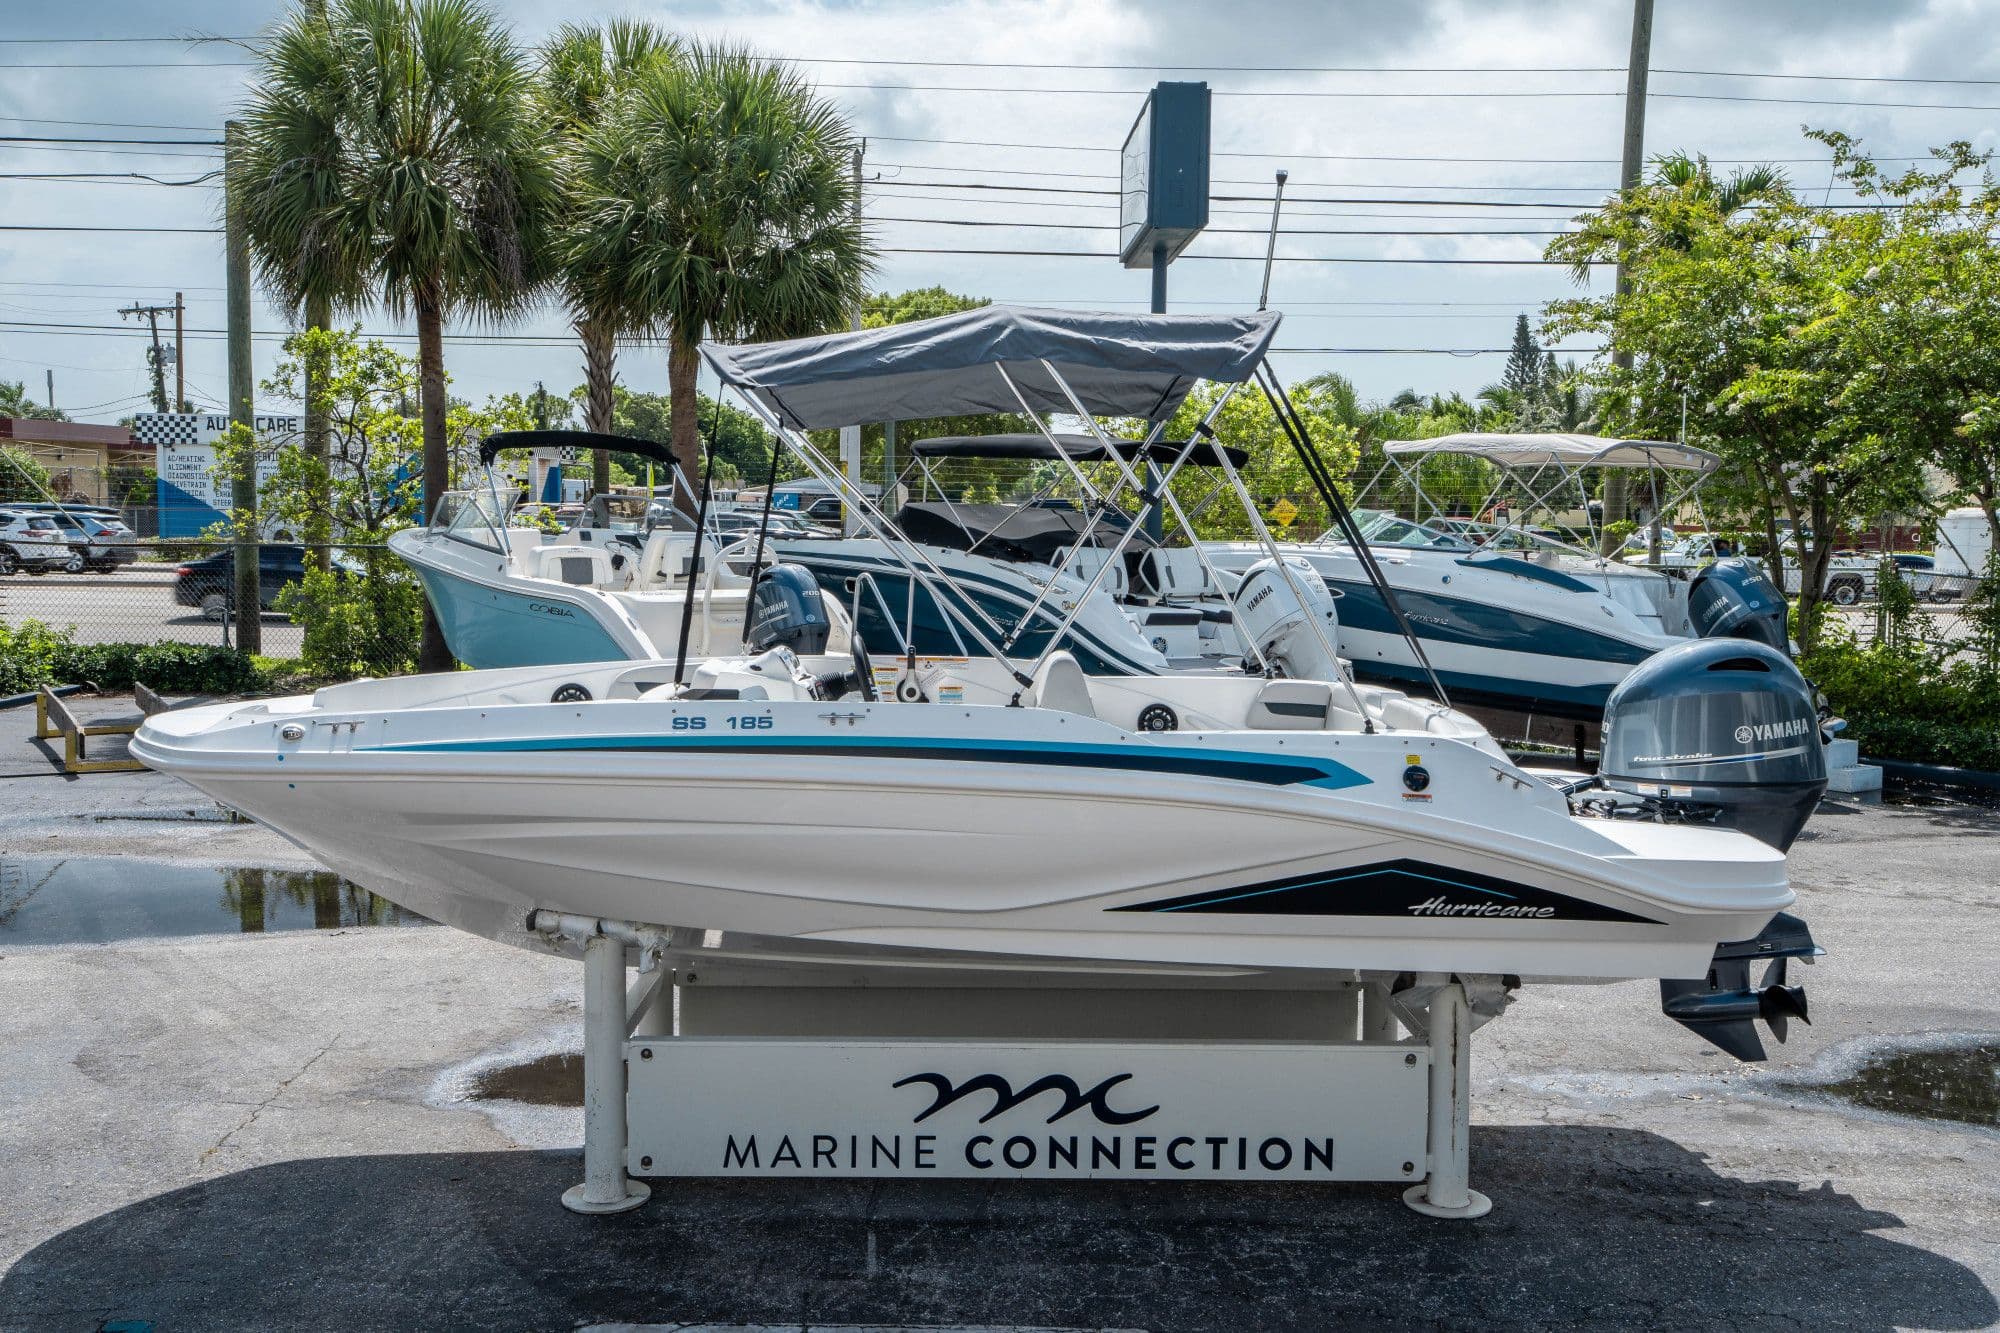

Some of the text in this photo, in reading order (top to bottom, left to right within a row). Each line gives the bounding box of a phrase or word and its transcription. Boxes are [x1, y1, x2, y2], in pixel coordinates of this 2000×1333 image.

[256, 417, 297, 432] CARE
[167, 455, 206, 463] AC/HEATING
[167, 472, 210, 480] DIAGNOSTICS
[1741, 575, 1762, 586] 250
[1247, 585, 1274, 612] YAMAHA
[529, 603, 575, 618] COBIA
[764, 600, 789, 617] YAMAHA
[1706, 596, 1729, 618] YAMAHA
[672, 716, 773, 730] SS 185
[1753, 718, 1809, 741] YAMAHA
[1408, 896, 1555, 918] Hurricane
[723, 1135, 1334, 1171] MARINE CONNECTION
